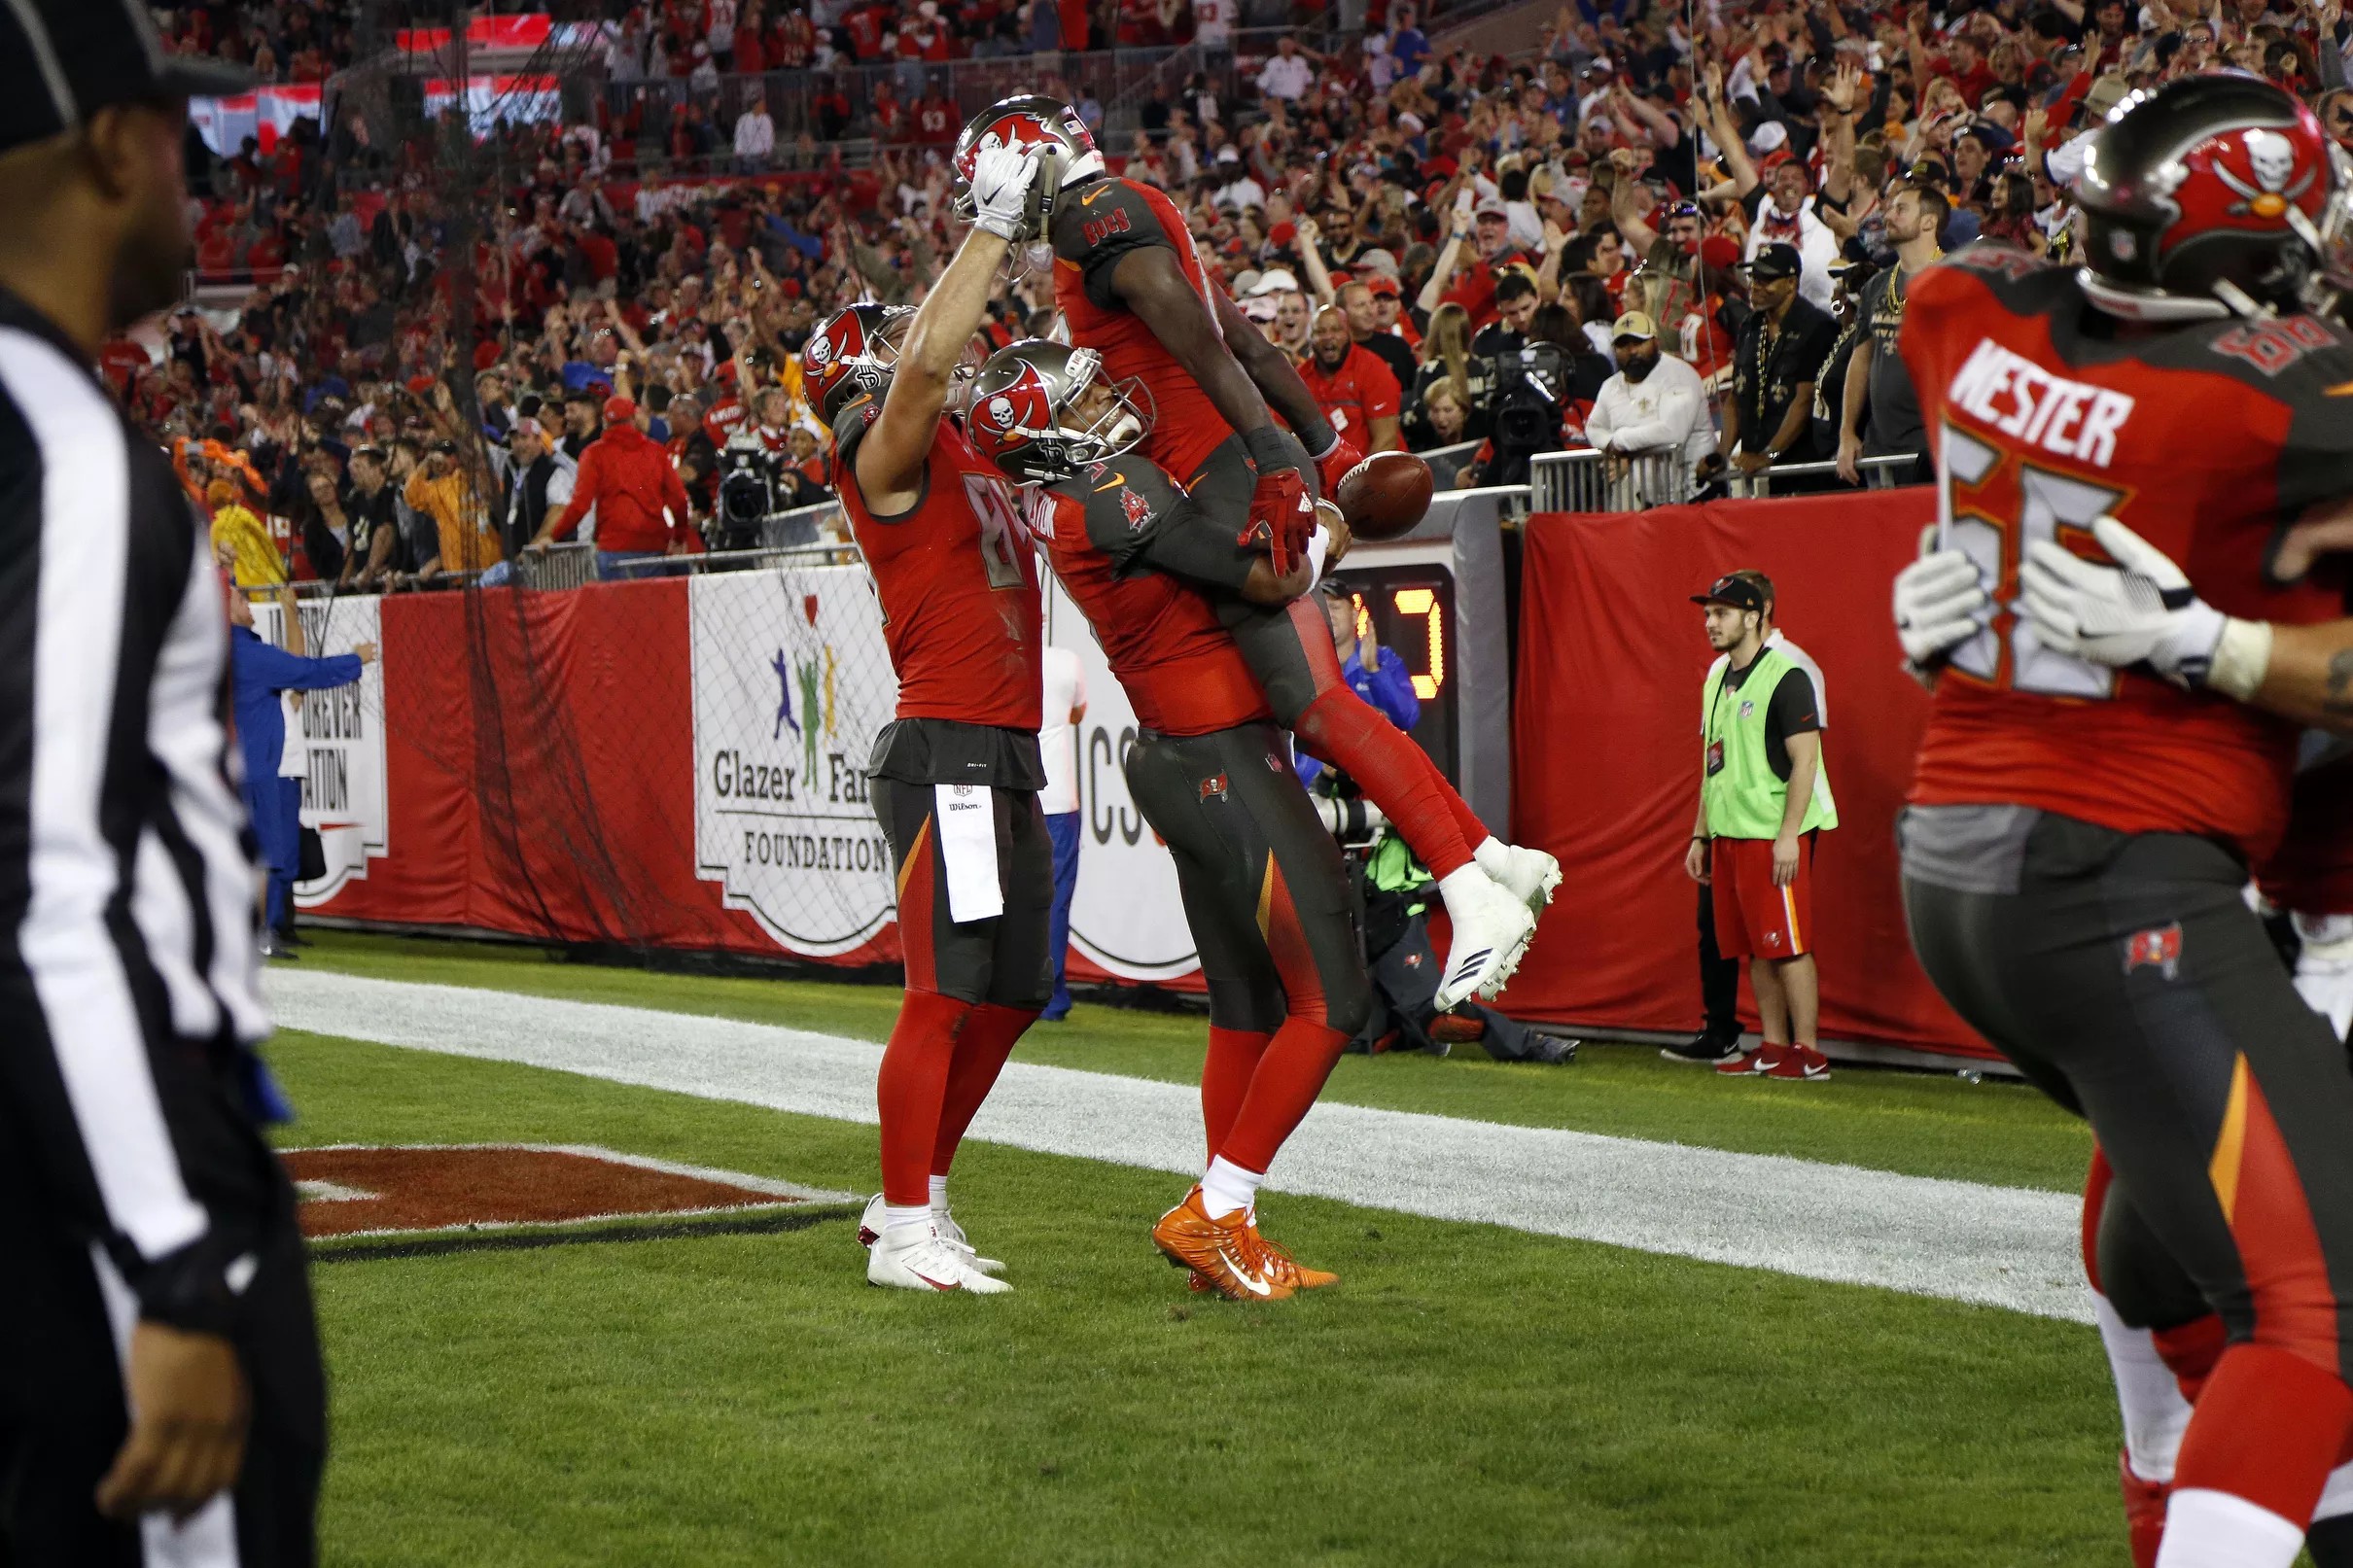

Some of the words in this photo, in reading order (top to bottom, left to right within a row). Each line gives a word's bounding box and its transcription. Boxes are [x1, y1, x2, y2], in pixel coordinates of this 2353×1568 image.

[1081, 207, 1131, 247] BUCS
[714, 750, 795, 801] Glazer
[956, 784, 971, 795] NFL
[949, 802, 978, 811] Wilson
[745, 831, 888, 872] FOUNDATION
